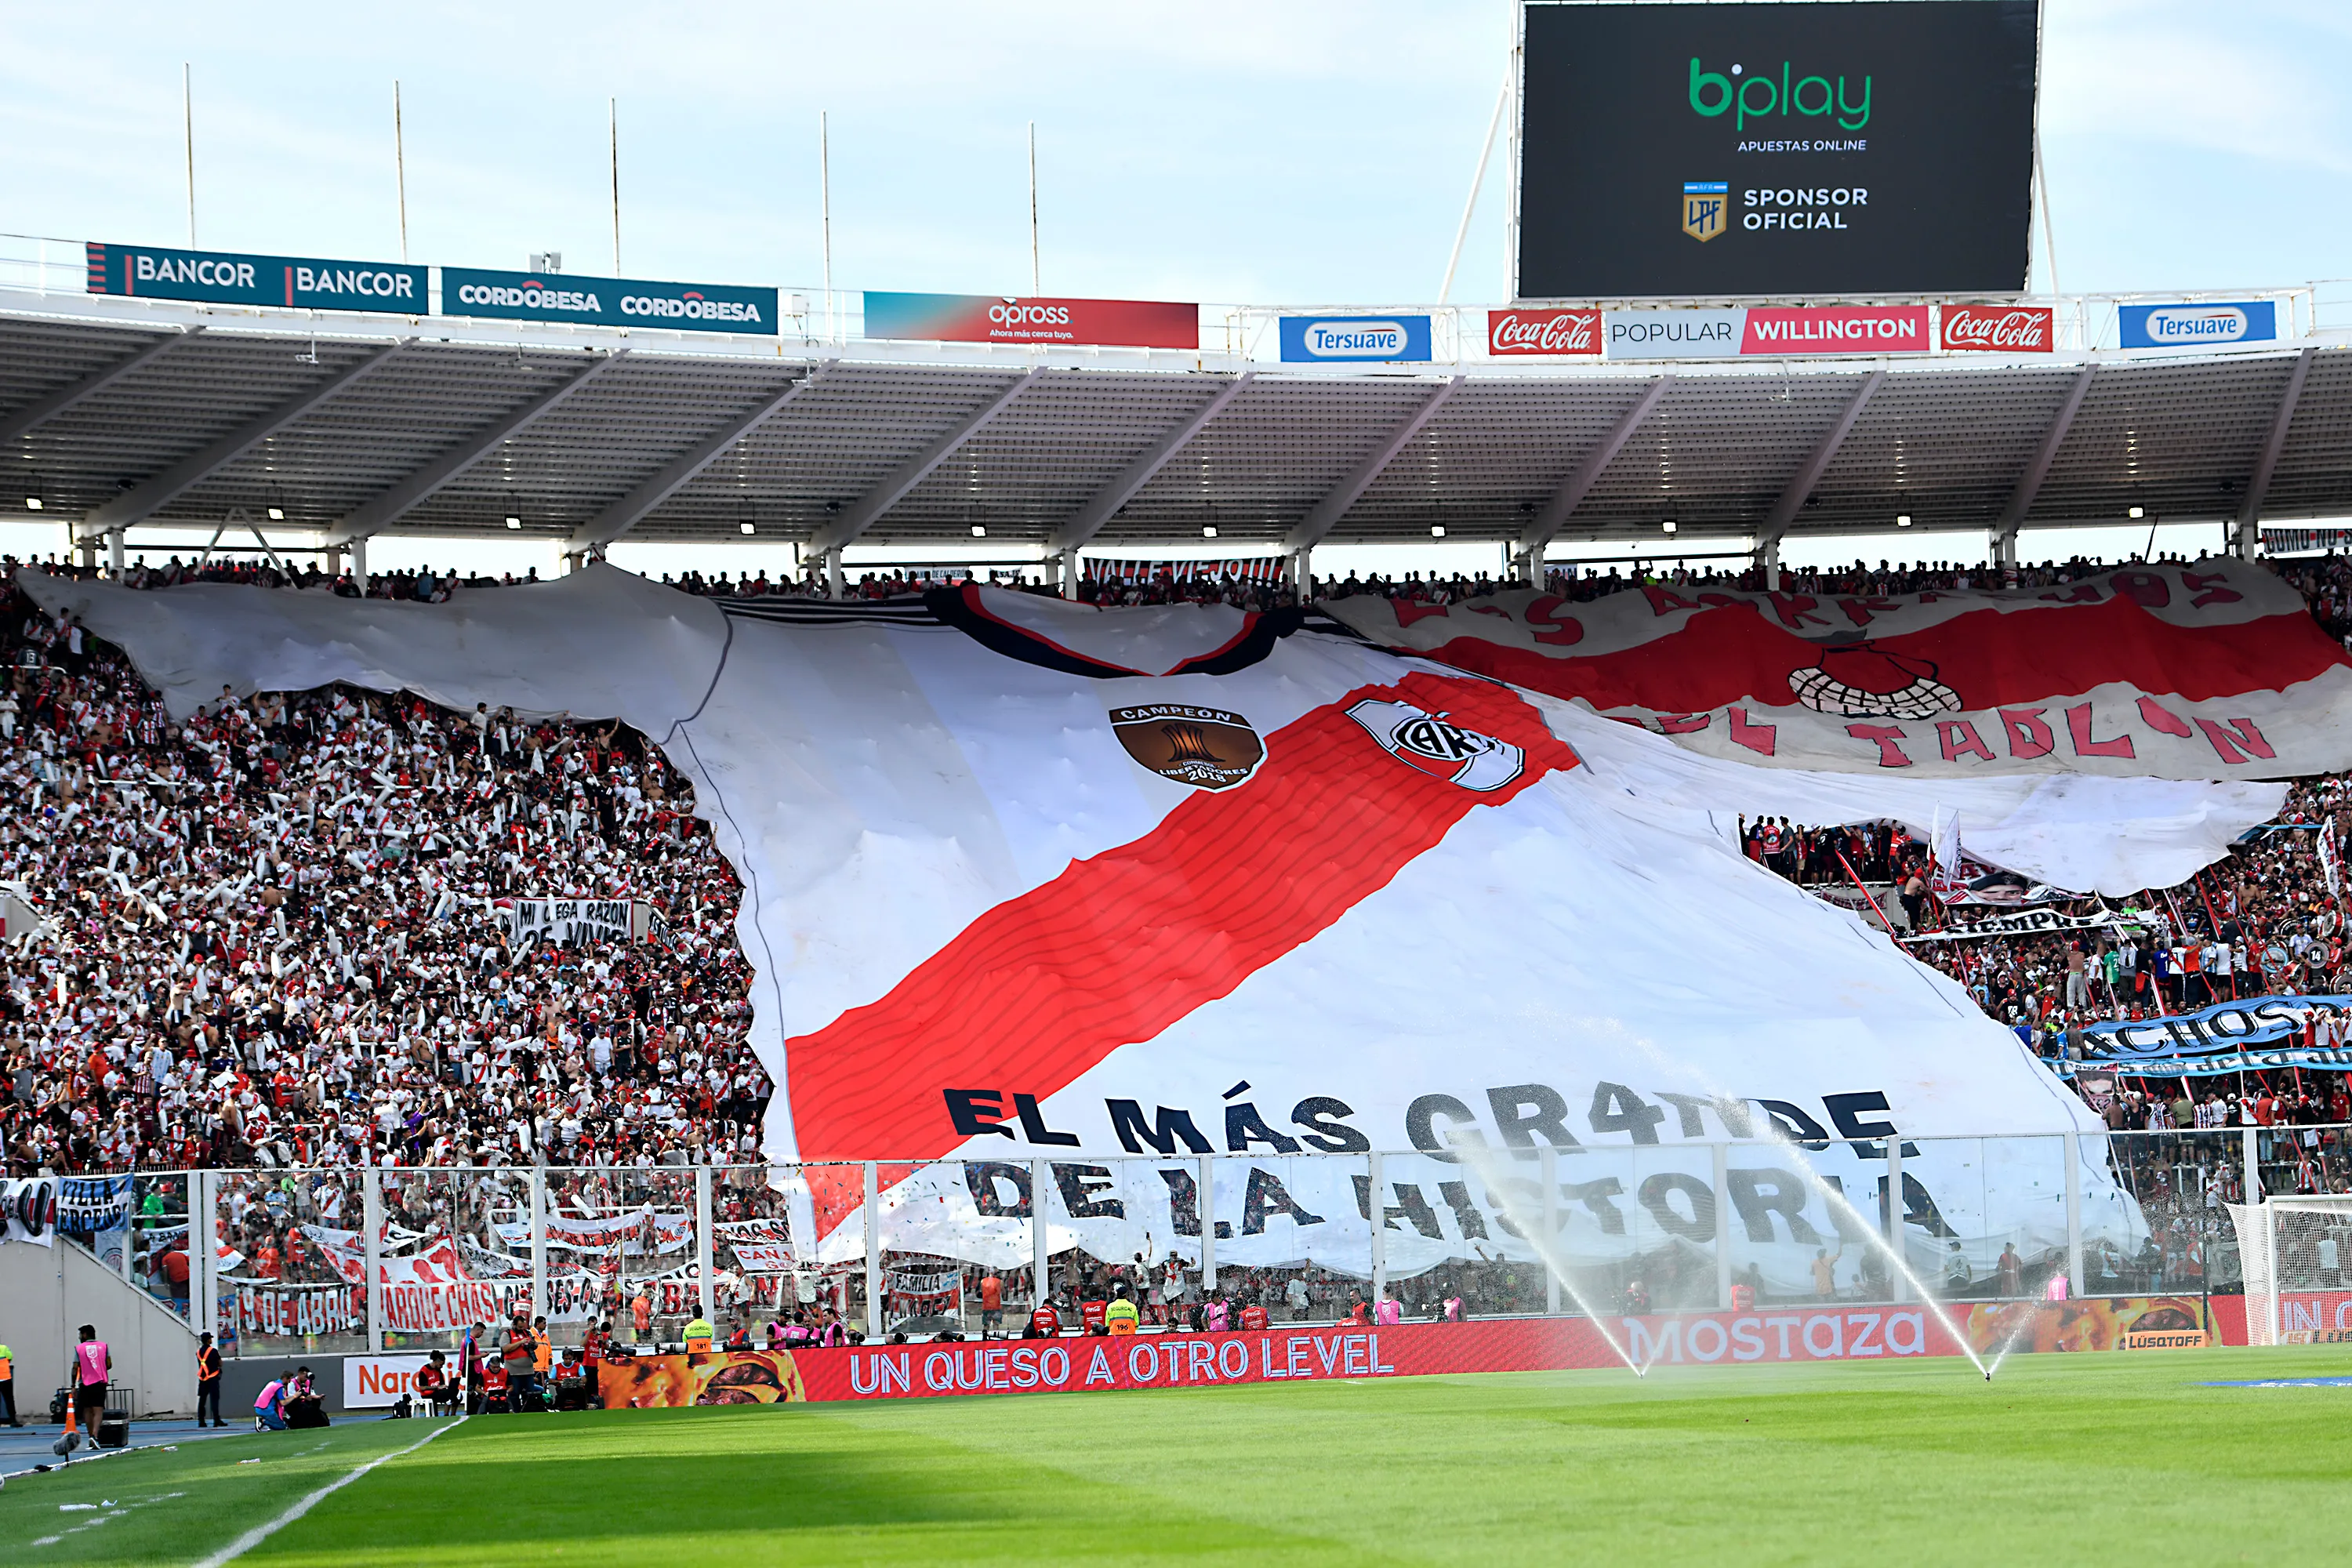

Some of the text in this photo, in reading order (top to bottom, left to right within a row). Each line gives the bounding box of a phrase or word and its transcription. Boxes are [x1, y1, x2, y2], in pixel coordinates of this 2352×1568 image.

[1689, 57, 1871, 131] bplay
[1737, 140, 1867, 152] APUESTAS ONLINE
[1743, 187, 1869, 206] SPONSOR
[1742, 212, 1848, 230] OFICIAL
[136, 256, 256, 289] BANCOR
[296, 267, 414, 298] BANCOR
[458, 282, 602, 313] CORDOBESA
[619, 293, 762, 323] CORDOBESA
[1612, 321, 1733, 343] POPULAR
[1753, 318, 1917, 340] WILLINGTON
[2155, 314, 2238, 336] Tersuave
[1314, 328, 1397, 350] Tersuave
[1120, 705, 1232, 721] CAMPEÓN
[1159, 764, 1249, 776] LIBERTADORES
[1187, 768, 1228, 783] 2018
[520, 902, 535, 927] MI
[543, 902, 579, 923] CEGA
[942, 1088, 1081, 1147] EL
[1104, 1079, 1371, 1154] MÁS
[62, 1180, 114, 1206] VILLA
[963, 1160, 1127, 1220] DE
[1157, 1166, 1327, 1239] LA
[895, 1271, 941, 1292] FAMILIA
[263, 1290, 292, 1336] DE
[297, 1285, 359, 1336] ABRIL
[445, 1281, 496, 1328] CHAS
[850, 1352, 911, 1394] UN
[924, 1346, 1071, 1391] QUESO
[1085, 1345, 1116, 1385] A
[1128, 1339, 1250, 1383] OTRO
[1261, 1334, 1395, 1377] LEVEL
